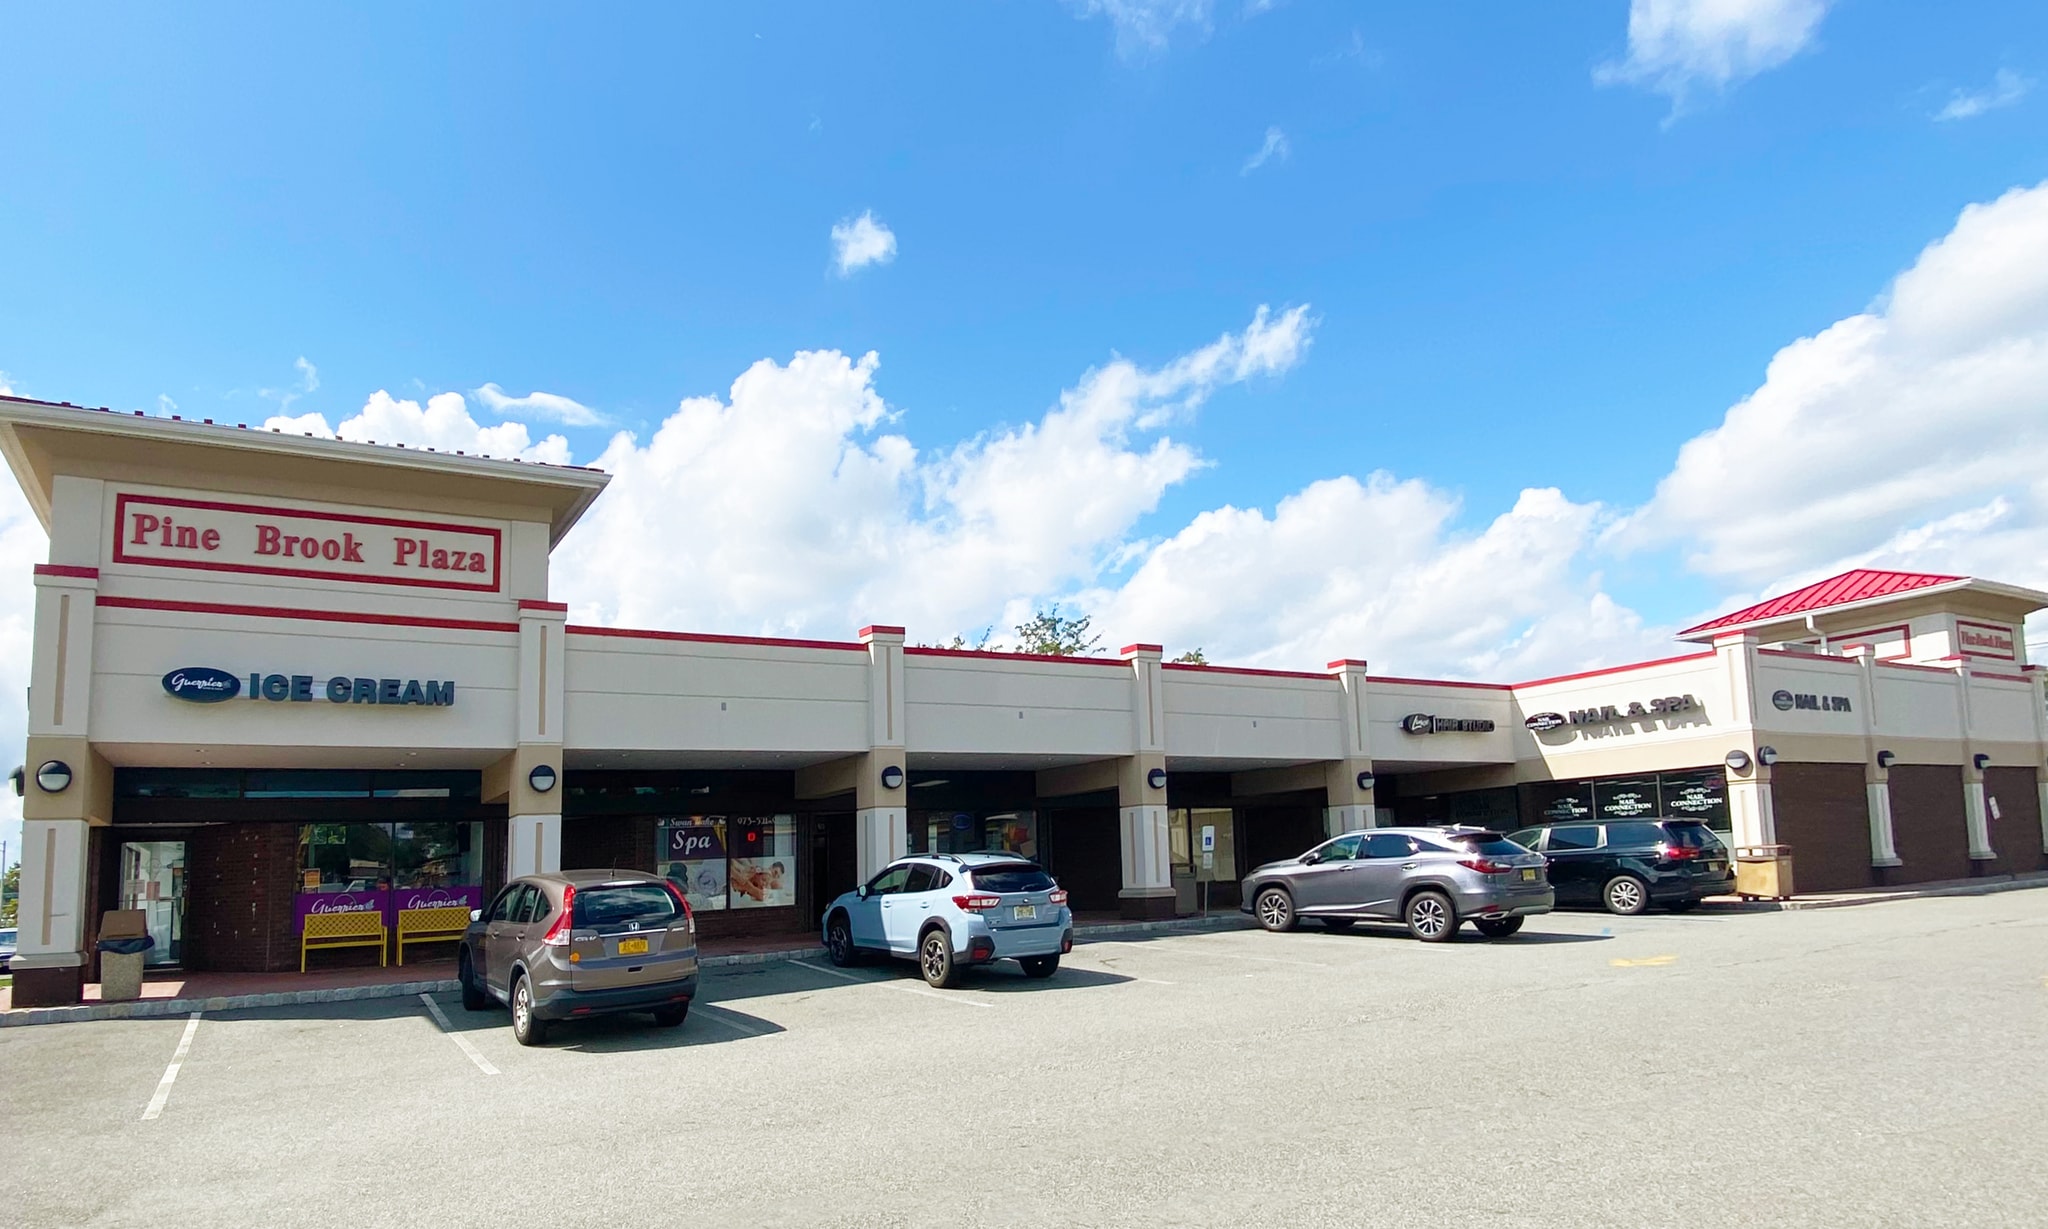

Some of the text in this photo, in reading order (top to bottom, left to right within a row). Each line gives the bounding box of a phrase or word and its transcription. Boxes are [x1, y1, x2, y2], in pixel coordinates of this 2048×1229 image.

[130, 513, 487, 573] Pine Brook Plaza
[250, 673, 455, 705] ICE CREAM
[1568, 694, 1698, 725] NAIL & SPA
[1604, 802, 1652, 812] CONNECTION
[1670, 797, 1723, 808] CONNECTION
[672, 829, 712, 856] Spa
